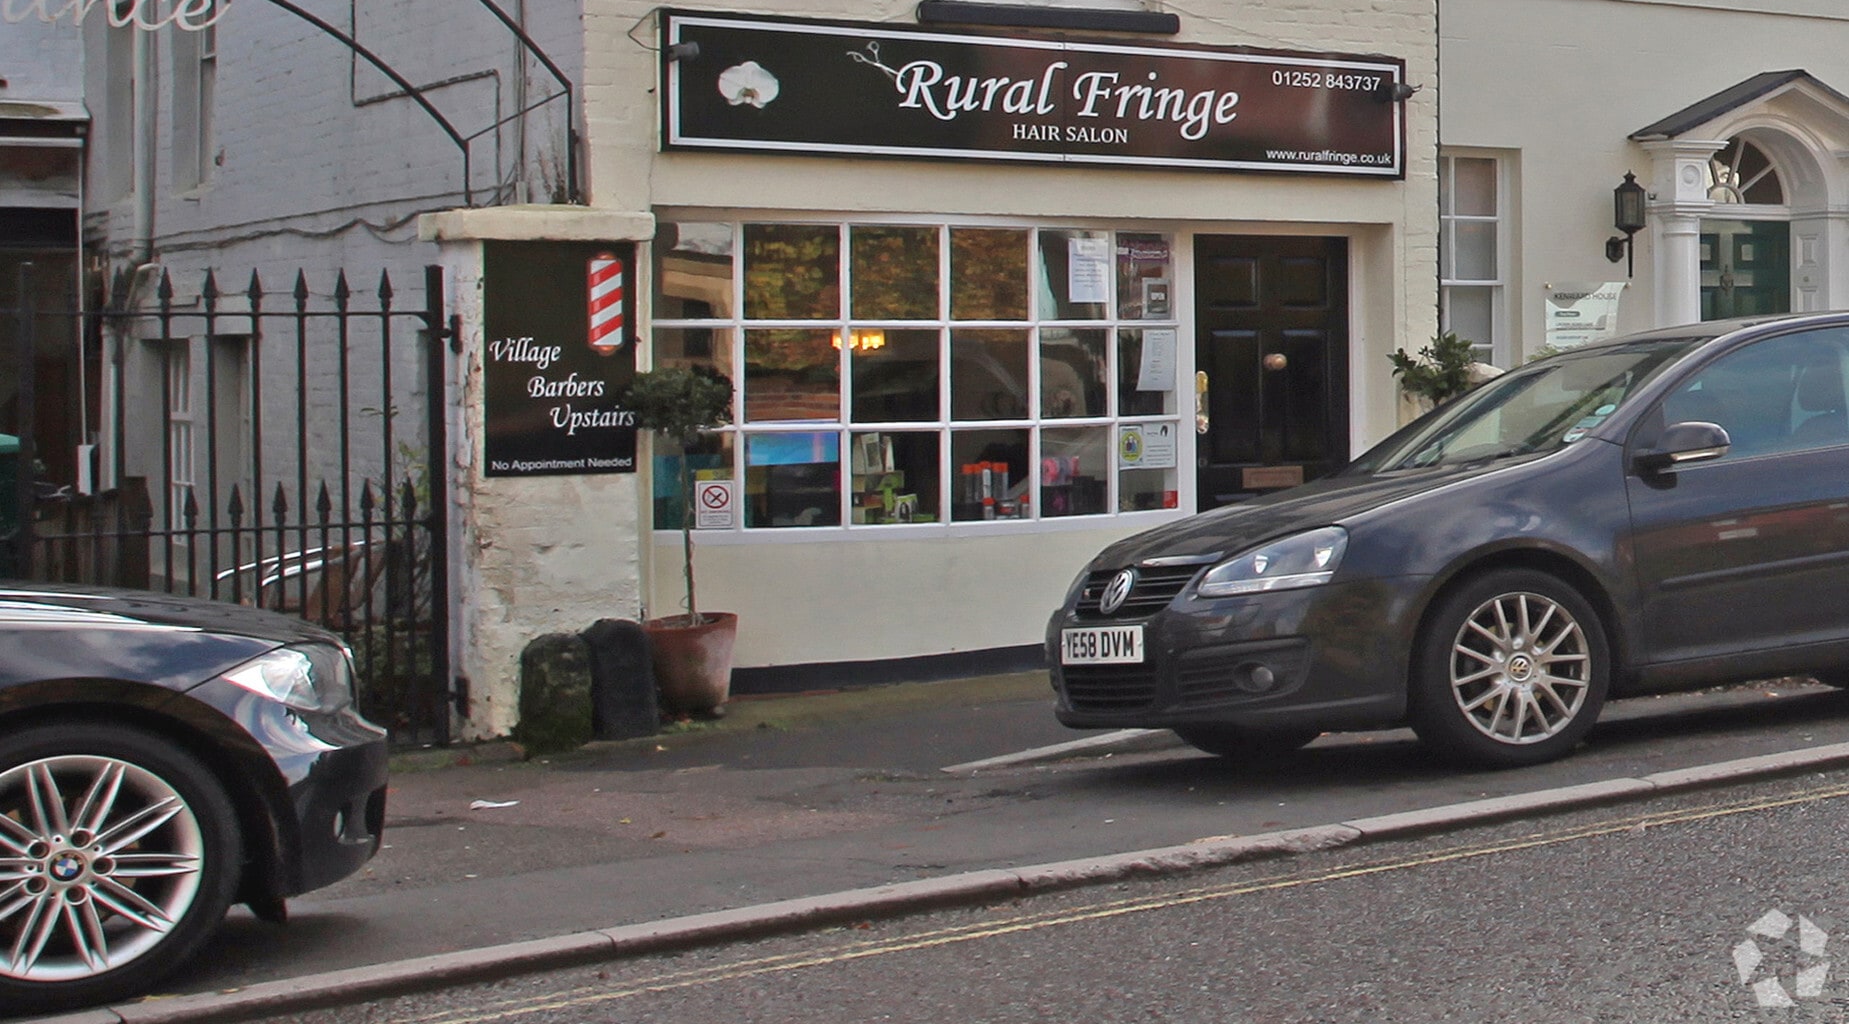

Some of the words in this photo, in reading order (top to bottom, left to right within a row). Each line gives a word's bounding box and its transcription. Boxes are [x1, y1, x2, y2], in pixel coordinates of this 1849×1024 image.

[1272, 70, 1321, 88] 01252
[1325, 73, 1381, 92] 843737
[895, 60, 1068, 121] Rural
[1072, 71, 1239, 140] Fringe
[1013, 123, 1061, 142] HAIR
[1066, 126, 1128, 144] SALON
[1266, 147, 1392, 166] www.ruralfringe.co.uk
[489, 337, 561, 369] Village
[527, 373, 604, 398] Barbers
[550, 404, 636, 436] Upstairs
[491, 460, 508, 471] No
[512, 458, 585, 472] Appointment
[588, 457, 632, 468] Needed
[1066, 632, 1097, 658] YE58
[1101, 630, 1134, 658] DVM
